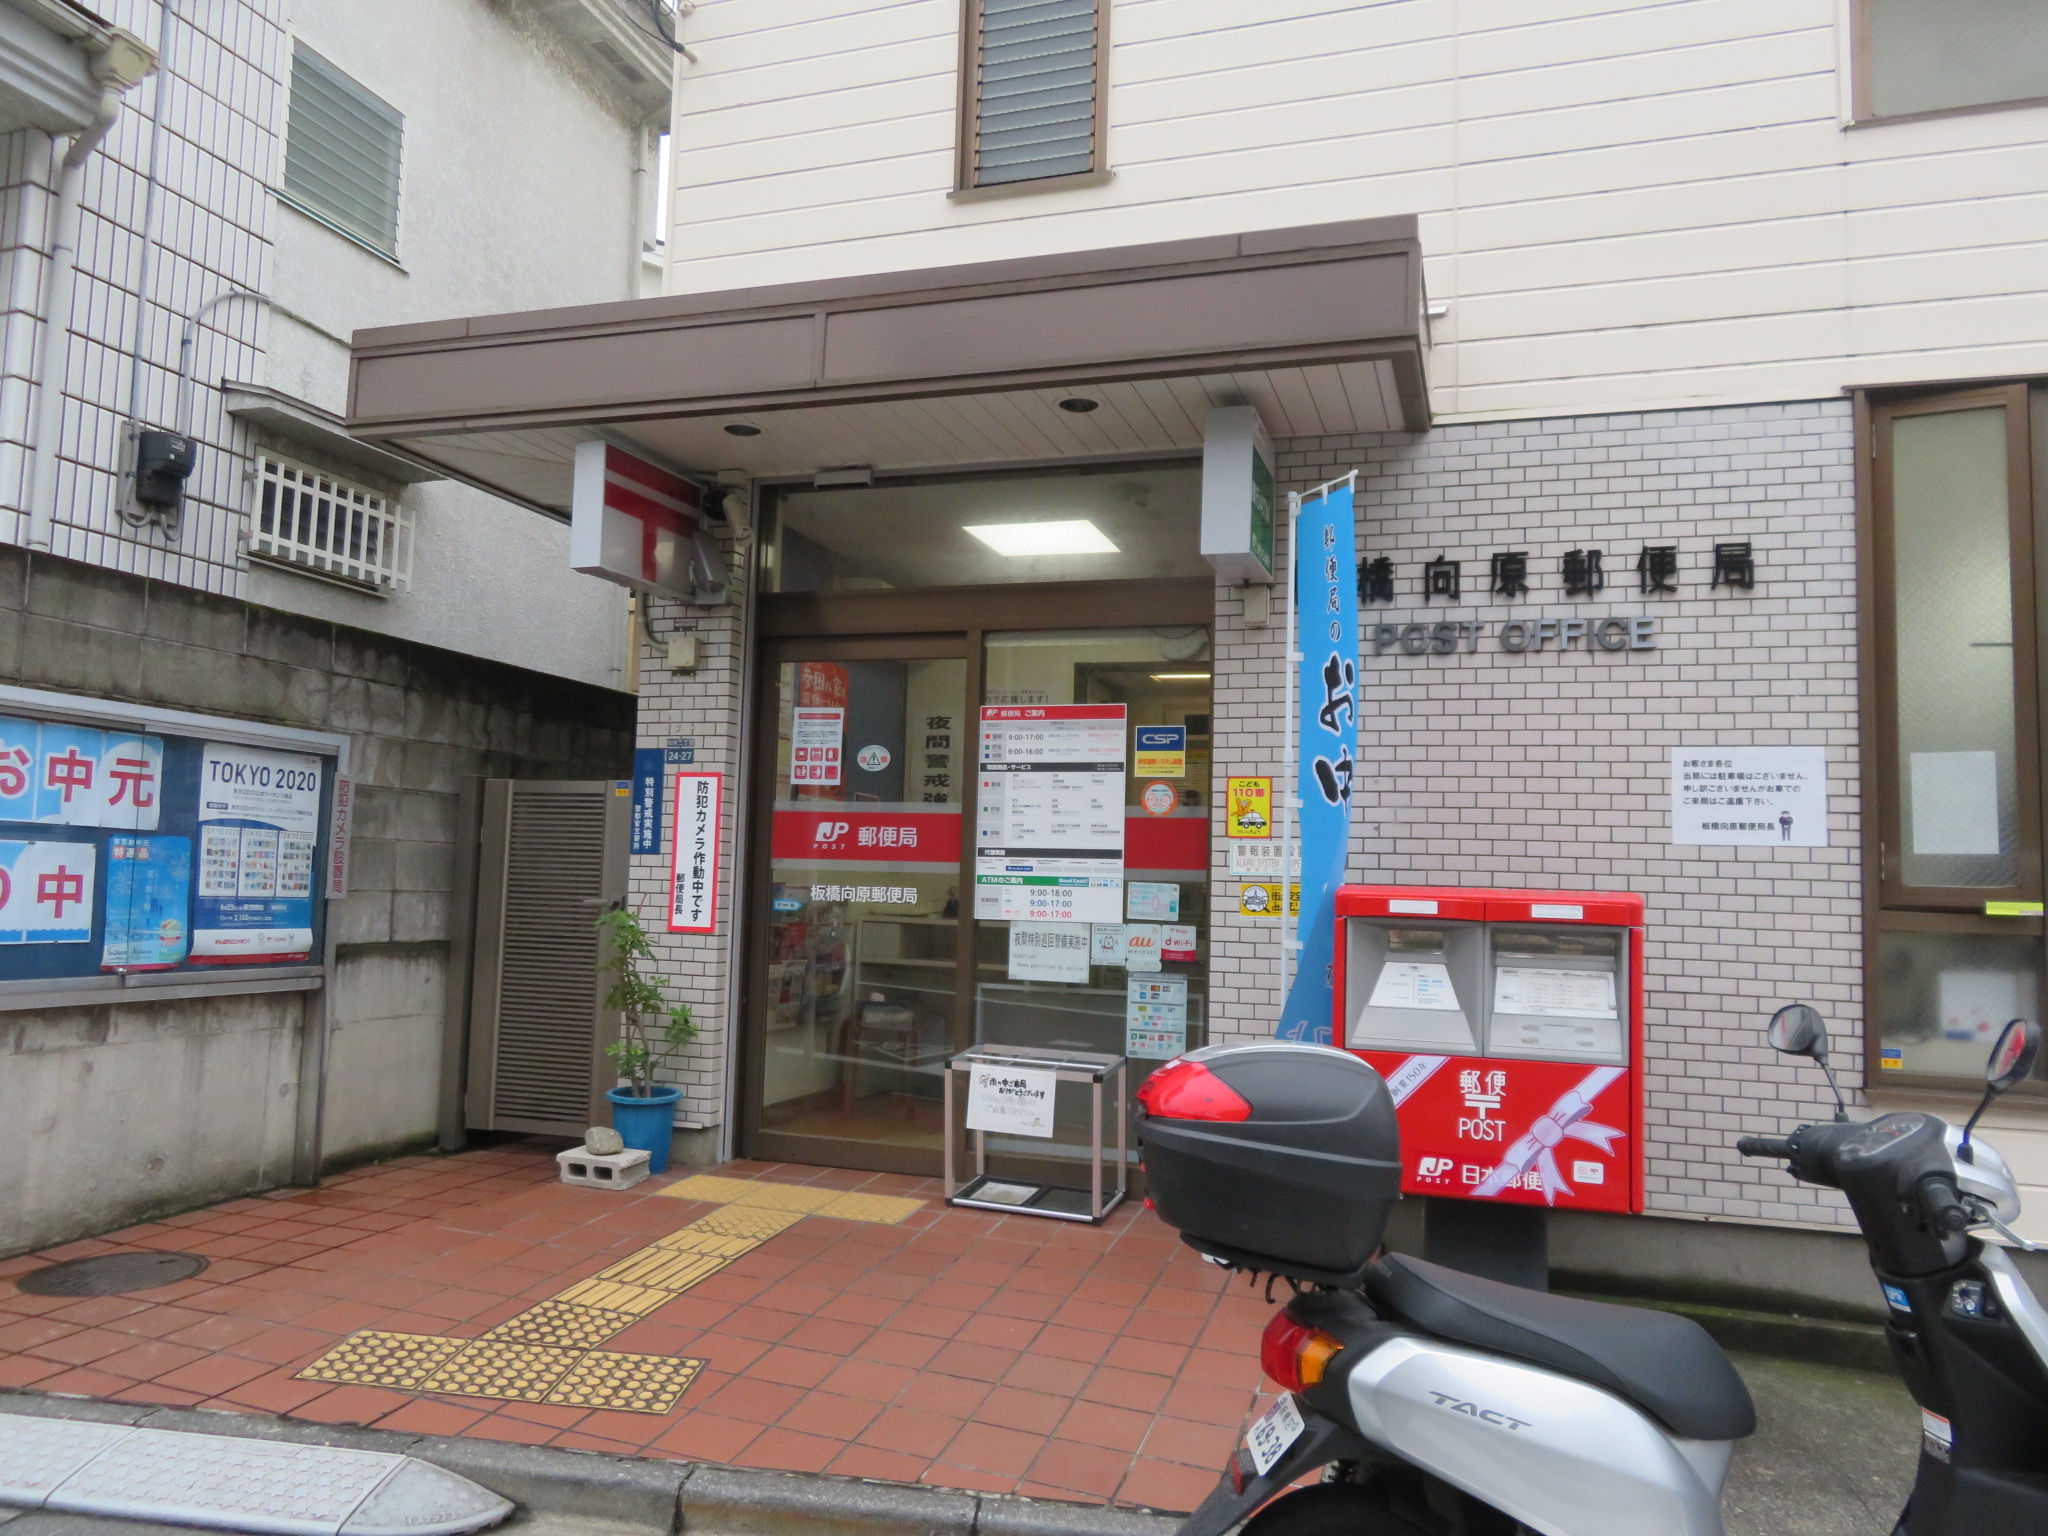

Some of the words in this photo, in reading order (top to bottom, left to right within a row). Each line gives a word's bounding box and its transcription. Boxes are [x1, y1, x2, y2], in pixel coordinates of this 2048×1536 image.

[1323, 524, 1341, 642] 郵便局の
[1375, 620, 1485, 656] POST
[1501, 616, 1656, 653] OFFICE
[1000, 709, 1021, 717] 郵便局
[1025, 709, 1046, 717] ご案内
[1142, 734, 1179, 744] CSP
[668, 751, 692, 761] 24-27
[1683, 760, 1733, 768] お客さま各位
[0, 748, 154, 808] お中元
[210, 761, 270, 787] TOKYO
[275, 769, 316, 791] 2020
[1683, 772, 1808, 780] 当局には駐車場はございません。
[1233, 788, 1264, 798] 110番
[1683, 785, 1801, 793] 申し訳ございませんがお車での
[1683, 797, 1774, 805] ご来局はご遠慮下さい。
[643, 777, 654, 849] 特別警戒実施中
[1702, 822, 1775, 831] 板橋向原郵便局長
[815, 822, 849, 842] JP
[857, 825, 918, 848] 郵便局
[690, 780, 710, 922] 防犯カメラ作動中です
[1258, 859, 1280, 868] SYSTEM
[981, 876, 1024, 884] ATMのご案内
[674, 872, 686, 916] 郵便局長
[811, 885, 918, 905] 板橋向原郵便局
[1030, 889, 1073, 897] 9:00-18:00
[1030, 899, 1072, 908] 9:00-17:00
[1029, 910, 1072, 918] 9:00-17:00
[1014, 931, 1088, 951] 夜間特別巡回警備実施中
[1129, 936, 1156, 948] au
[1459, 1070, 1507, 1096] 郵便
[999, 1087, 1046, 1100] ありがとうございます
[1458, 1119, 1506, 1141] POST
[1418, 1156, 1453, 1177] JP
[1416, 1176, 1451, 1185] POST
[1428, 1390, 1534, 1431] TACT
